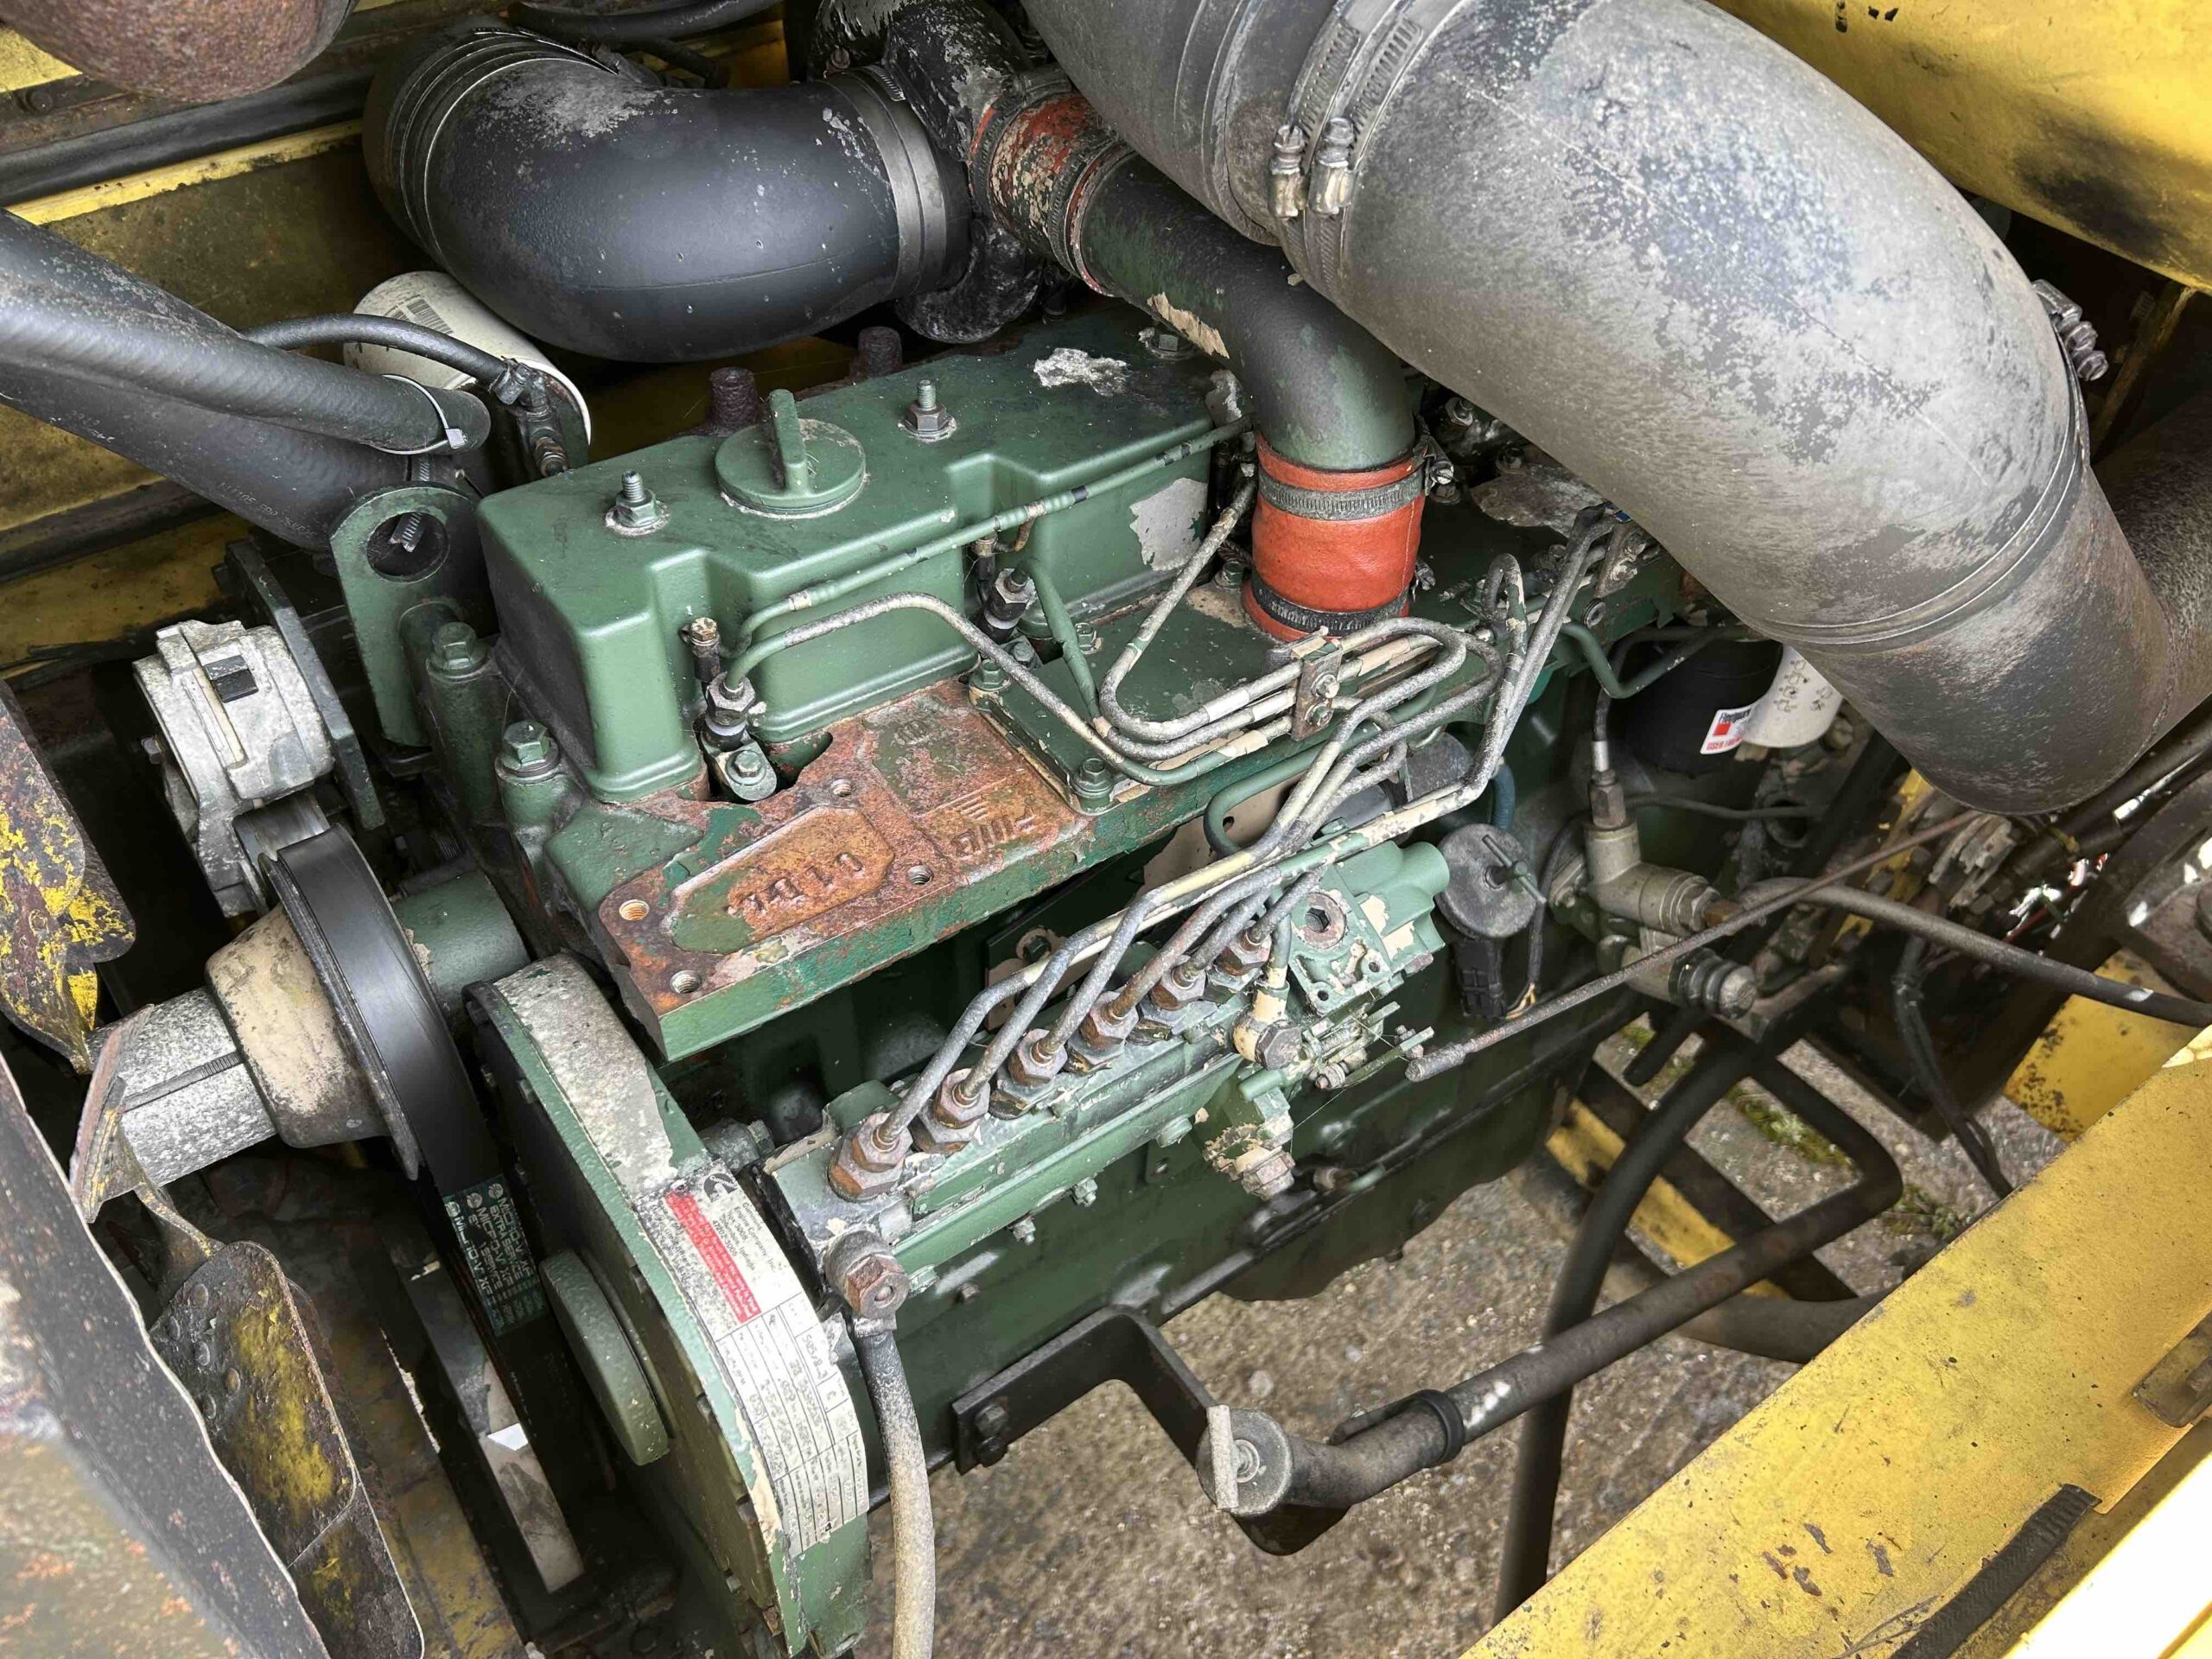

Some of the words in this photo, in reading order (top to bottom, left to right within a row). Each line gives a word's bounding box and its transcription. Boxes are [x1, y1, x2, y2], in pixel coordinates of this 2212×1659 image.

[732, 1205, 751, 1228] Engine
[488, 1205, 507, 1237] EXTRA
[500, 1237, 523, 1280] SERVICE
